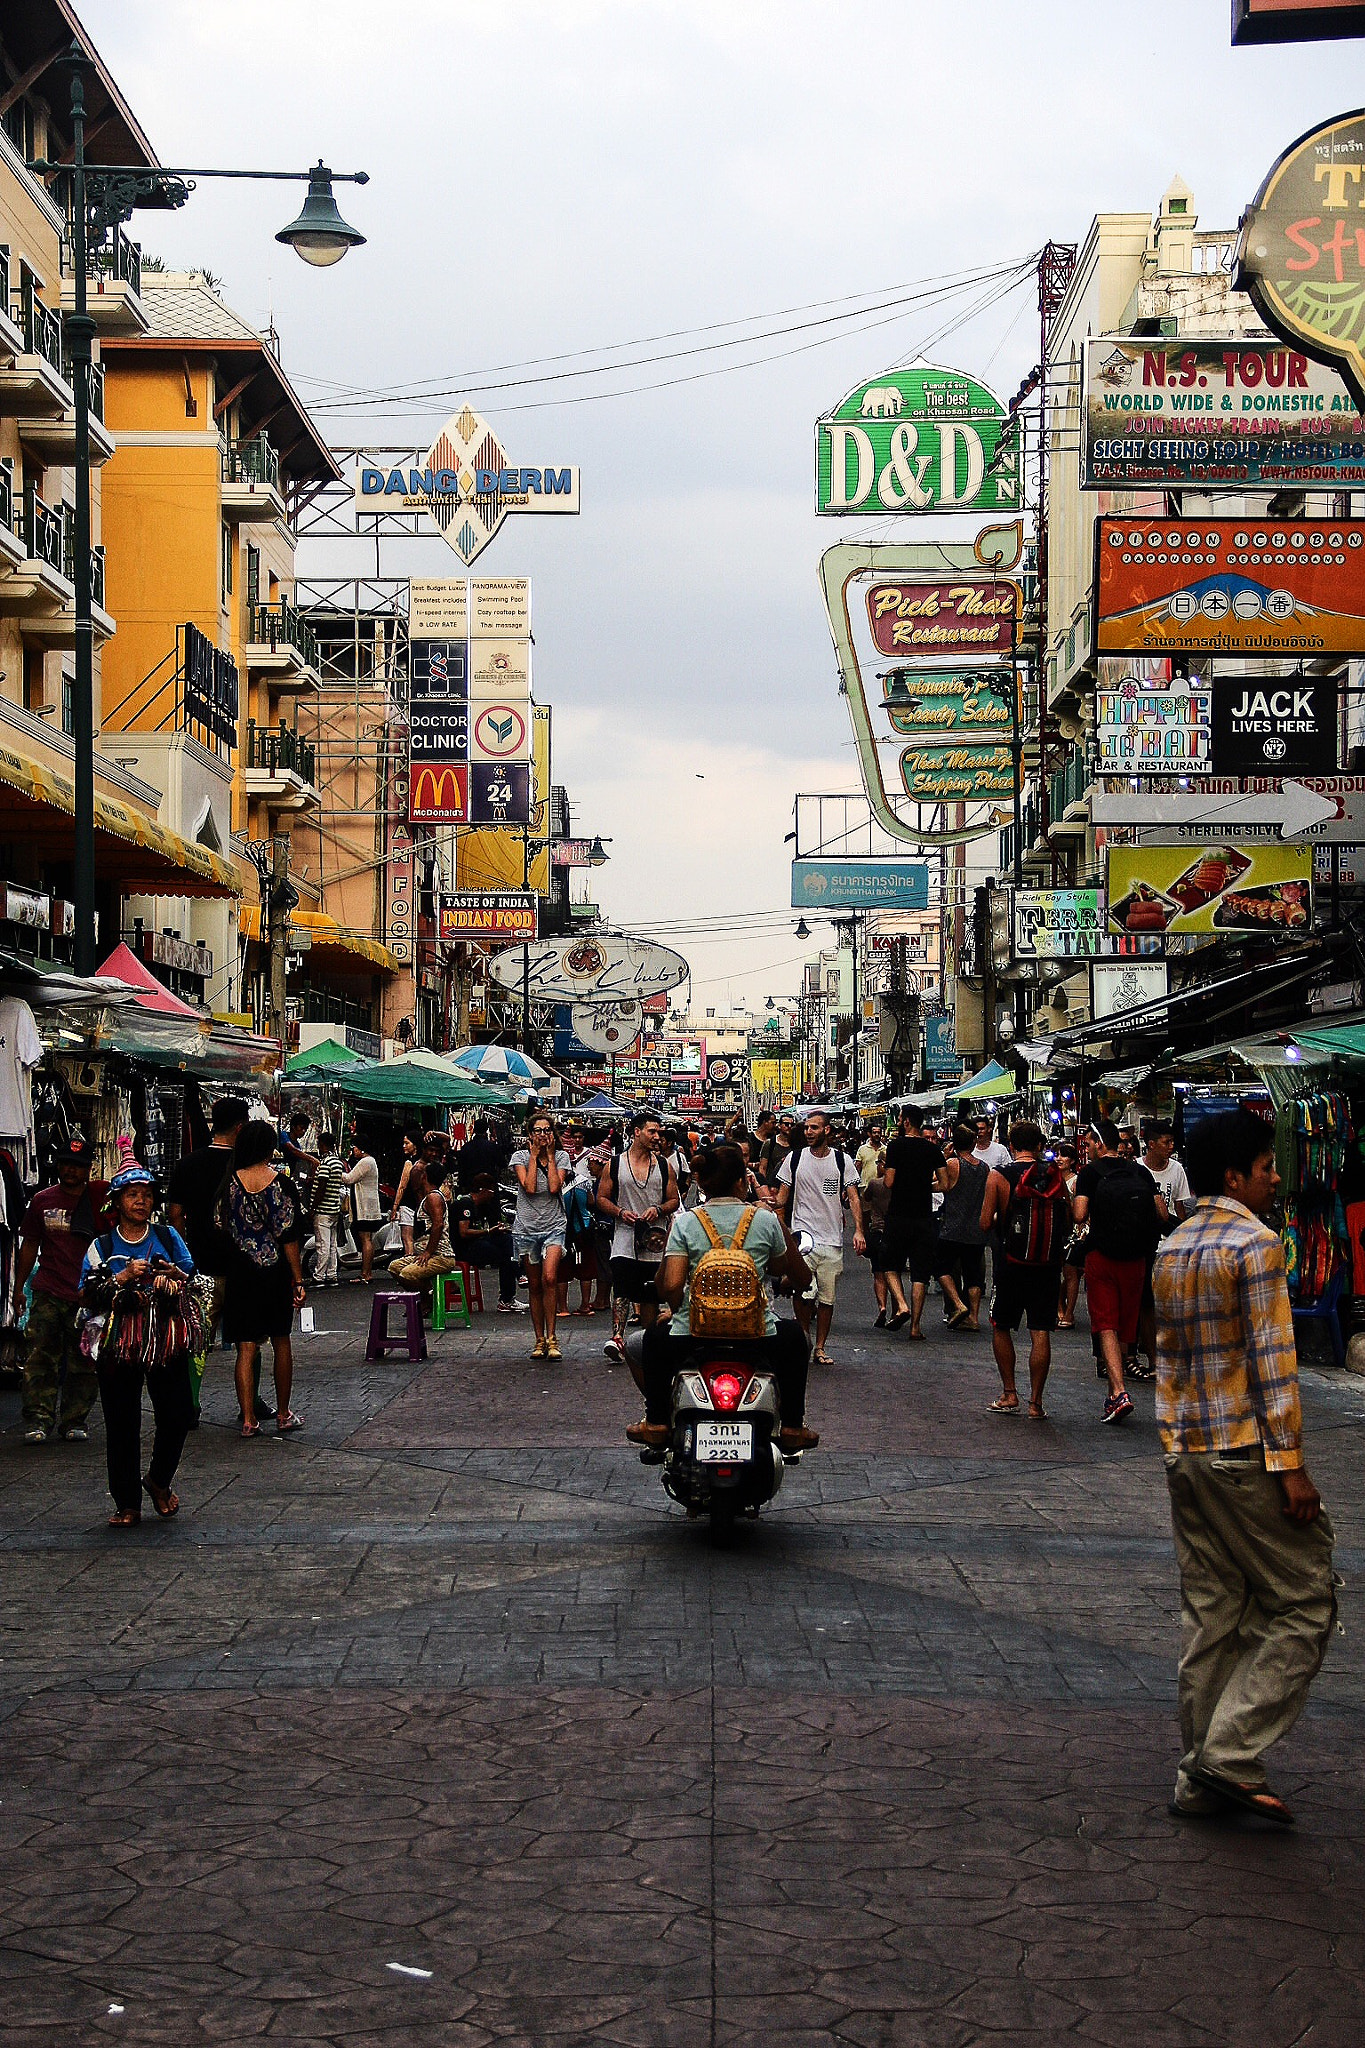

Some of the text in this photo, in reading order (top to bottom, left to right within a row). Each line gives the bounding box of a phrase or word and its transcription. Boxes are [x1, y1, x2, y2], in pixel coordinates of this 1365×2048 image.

[1314, 163, 1365, 207] T
[1143, 351, 1309, 388] N.S. TOUR
[925, 391, 969, 406] The best
[1104, 394, 1164, 411] WORLD
[1171, 394, 1213, 411] WIDE
[1220, 395, 1233, 411] &
[1241, 394, 1324, 411] DOMESTIC
[927, 407, 968, 416] Khaosan
[970, 407, 995, 415] Road
[1124, 417, 1164, 434] JOIN
[1171, 417, 1223, 434] TICKET
[1229, 417, 1280, 434] TRAIN
[1300, 418, 1332, 435] BUS
[1094, 440, 1145, 459] SIGHT
[1149, 440, 1209, 459] SEEING
[1214, 440, 1260, 459] TOUR
[1281, 441, 1335, 459] HOTEL
[824, 423, 985, 509] D&D
[361, 469, 571, 495] DANG DERM
[403, 494, 530, 506] Authentic Thai Hotel
[1109, 532, 1362, 547] NIPPON ICHIBAN
[1122, 554, 1345, 564] JAPANESE RESTAURANT
[1172, 593, 1292, 617] 日本一番
[893, 620, 1000, 645] Restaurant
[960, 699, 1009, 722] Salon
[1231, 691, 1315, 718] JACK
[411, 716, 467, 727] DOCTOR
[1232, 721, 1319, 733] LIVES HERE.
[411, 735, 467, 749] CLINIC
[905, 754, 944, 773] Thai
[1096, 761, 1208, 771] BAR & RESTAURANT
[487, 784, 513, 802] 24
[912, 774, 974, 797] Shopping
[413, 809, 464, 817] McDonald's
[1178, 825, 1241, 836] STERLING
[831, 874, 914, 891] ธนาคารกรุงไทย
[831, 888, 897, 896] KRUNGTHAI BANK
[1045, 894, 1061, 902] Boy
[1065, 892, 1090, 901] Style
[446, 898, 530, 907] TASTE OF INDIA
[391, 876, 409, 960] FOOD
[443, 910, 533, 927] INDIAN FOOD
[511, 951, 676, 990] The Club
[637, 1059, 669, 1069] BAG
[709, 1450, 739, 1459] 223
